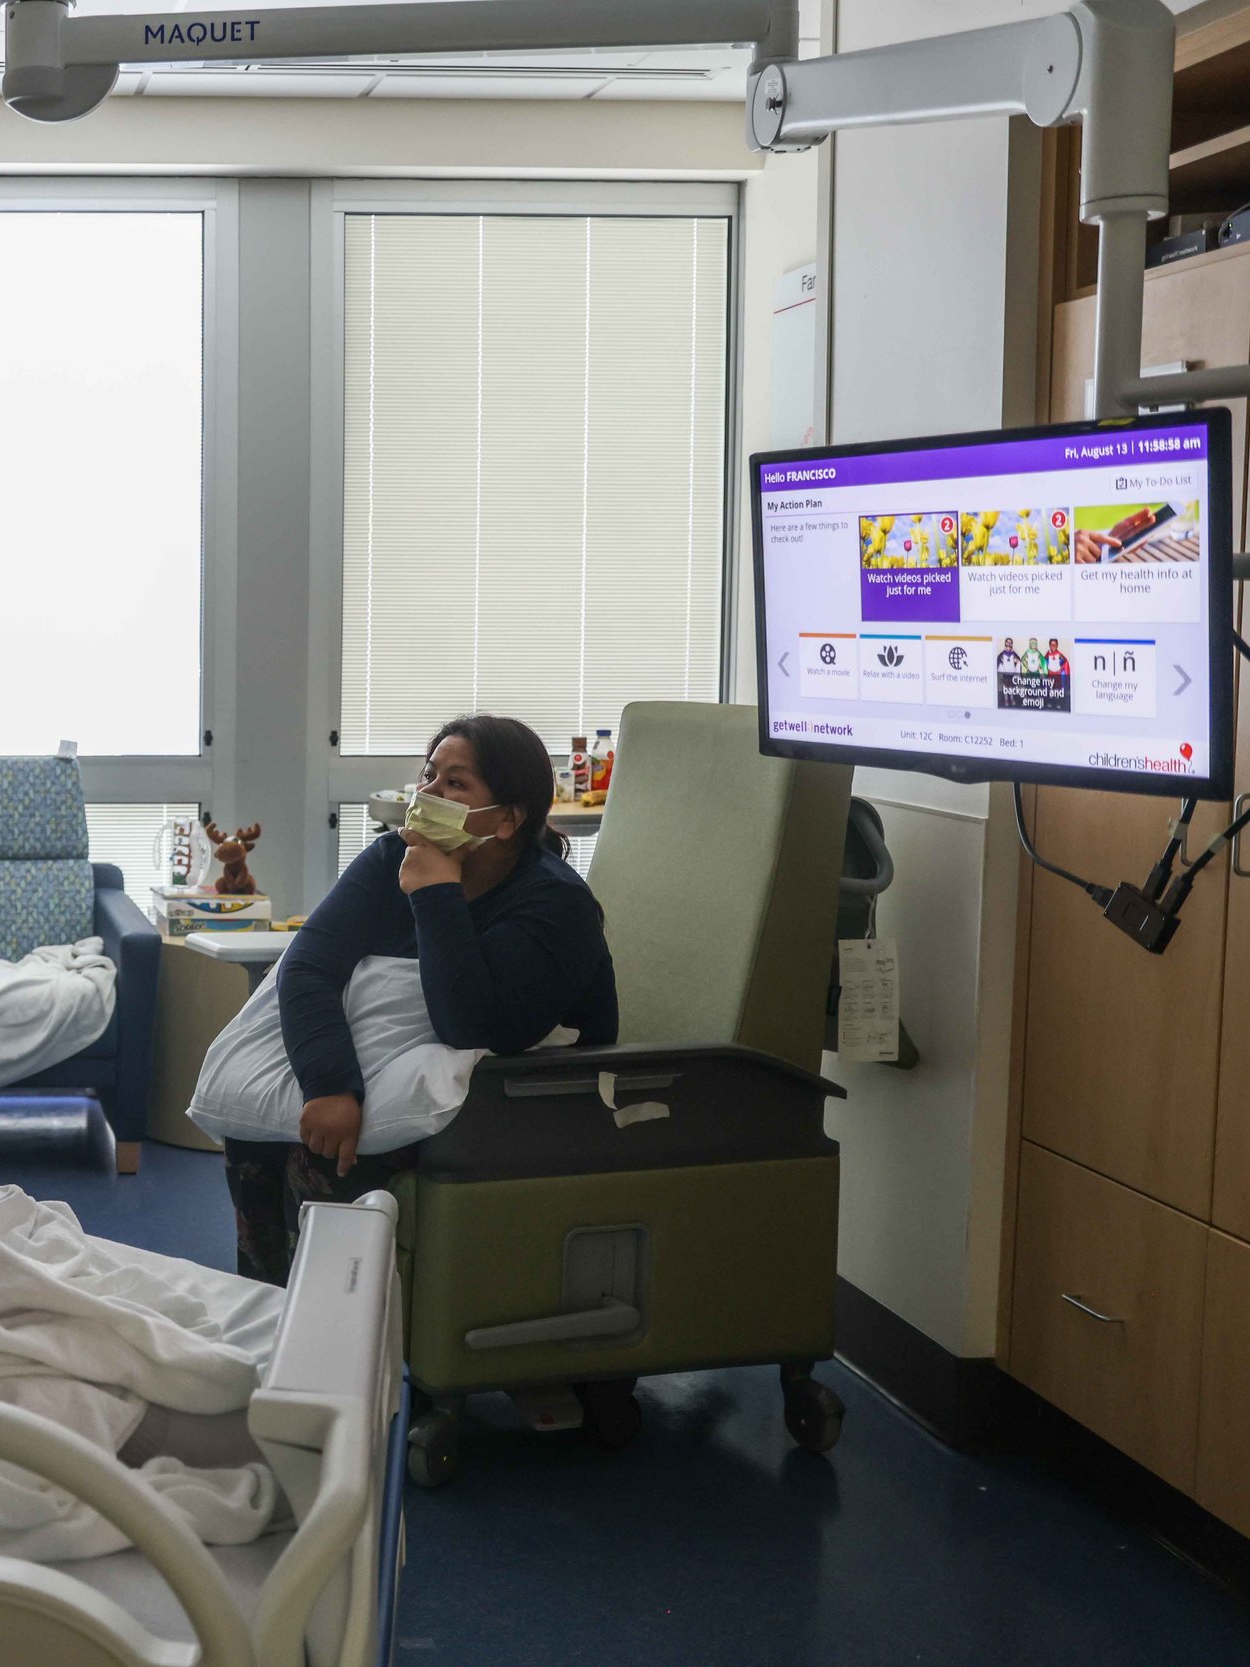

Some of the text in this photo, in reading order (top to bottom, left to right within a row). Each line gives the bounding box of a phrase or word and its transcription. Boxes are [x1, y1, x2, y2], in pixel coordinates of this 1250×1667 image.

[144, 21, 260, 46] MAQUET
[1065, 448, 1079, 459] Fri,
[1081, 445, 1114, 460] August
[1116, 443, 1128, 454] 13
[1138, 437, 1181, 454] 11:58:58
[1183, 437, 1201, 449] am
[764, 468, 836, 484] Hello FRANCISCO
[1129, 475, 1191, 489] My To-Do List
[767, 499, 822, 512] My Action Plan
[770, 524, 786, 532] Here
[805, 522, 817, 531] few
[818, 521, 840, 532] things
[944, 520, 950, 531] 2
[1055, 514, 1062, 526] 2
[771, 535, 804, 543] check out!
[867, 572, 951, 585] Watch videos picked
[968, 570, 1063, 583] Watch videos picked
[1080, 568, 1193, 583] Get my health info at
[886, 585, 931, 597] just for me
[989, 583, 1040, 597] just for me
[1119, 583, 1151, 594] home
[1094, 655, 1106, 671] n
[1123, 650, 1135, 672] ñ
[807, 667, 825, 675] Watch
[831, 669, 850, 677] movie
[863, 670, 880, 678] Relax
[881, 670, 896, 679] with
[902, 671, 920, 680] video
[931, 672, 988, 683] Surf the internet
[1012, 676, 1055, 688] Change my
[1091, 679, 1138, 692] Change my
[1002, 686, 1065, 698] background and
[1095, 690, 1134, 703] language
[1022, 698, 1045, 709] emoji
[900, 730, 917, 740] Unit:
[919, 731, 933, 741] 12C
[938, 733, 963, 744] Room:
[964, 735, 993, 746] C12252
[999, 738, 1017, 748] Bed:
